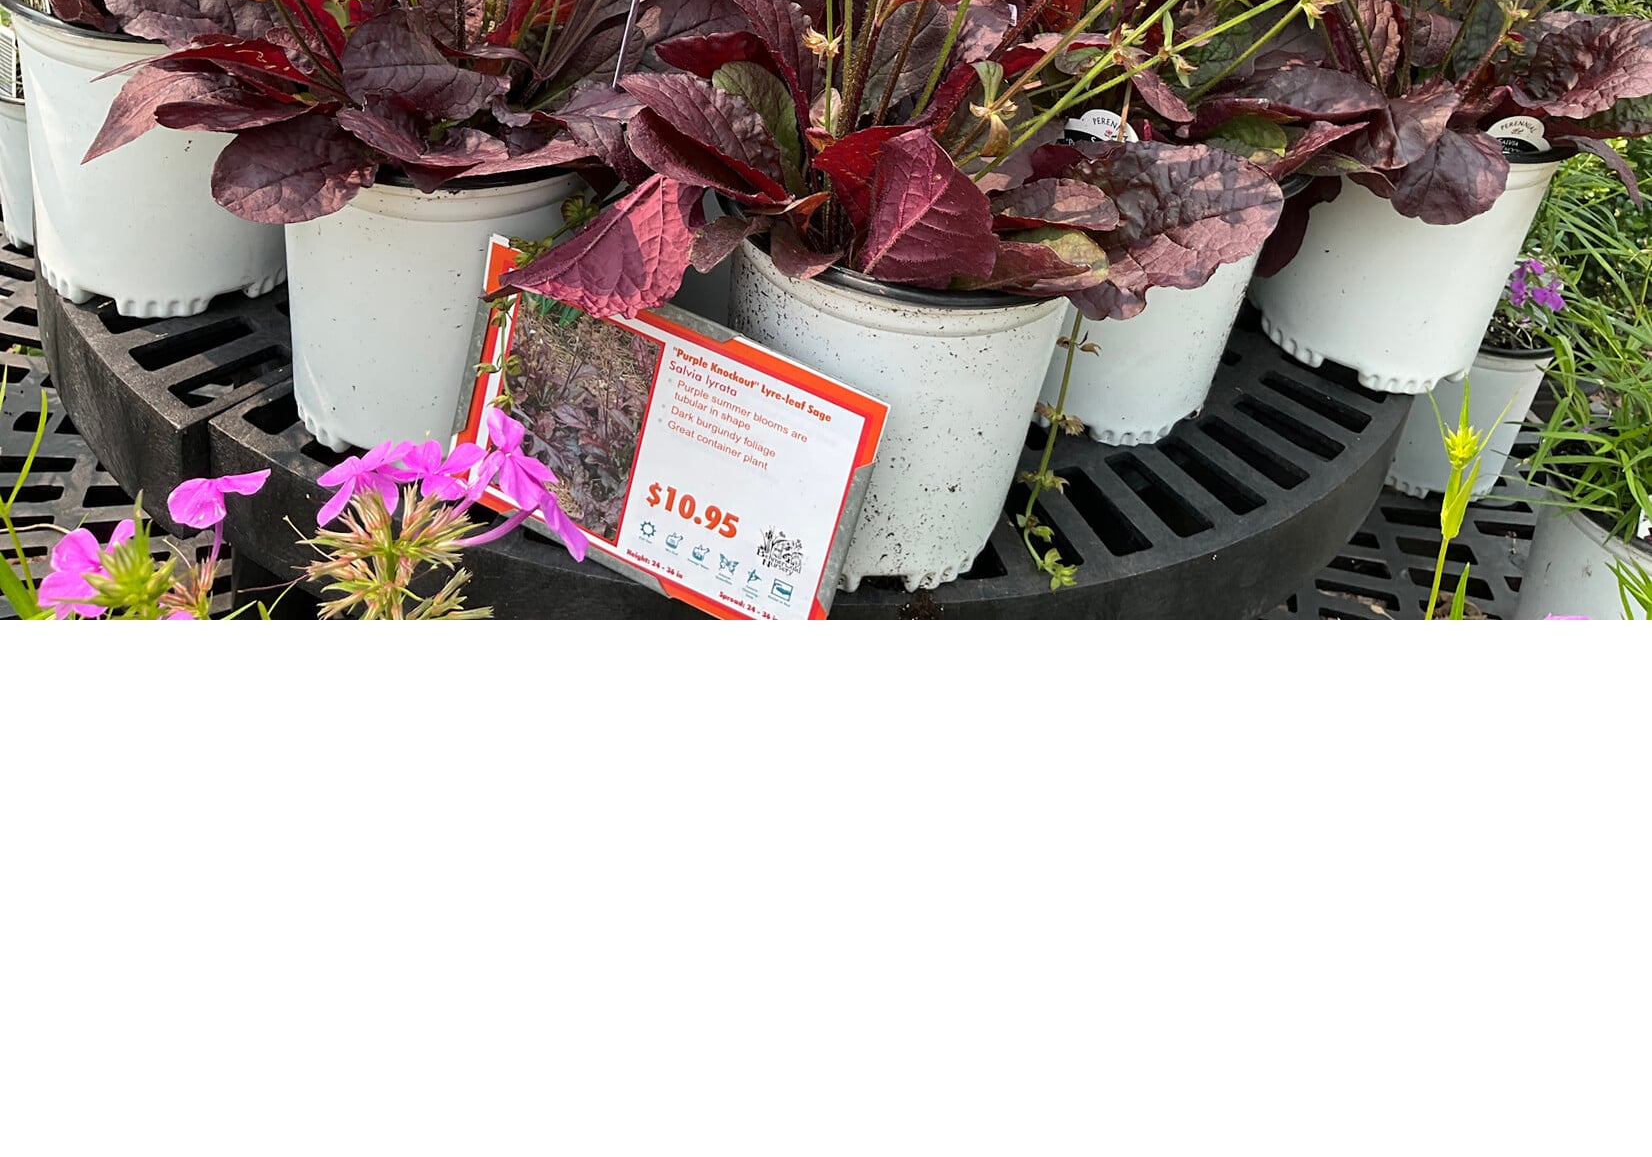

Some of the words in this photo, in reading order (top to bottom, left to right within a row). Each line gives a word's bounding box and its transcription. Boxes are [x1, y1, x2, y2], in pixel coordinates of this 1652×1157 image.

[669, 360, 702, 382] Salvia
[705, 374, 737, 397] lyrata
[672, 346, 708, 369] "Purple
[710, 362, 760, 389] Knockout"
[761, 384, 806, 411] Lyre-leaf
[807, 404, 832, 422] Sage
[671, 405, 694, 423] Dark
[696, 415, 742, 444] burgundy
[743, 436, 776, 458] foliage
[674, 391, 708, 411] tubular
[709, 406, 719, 417] in
[720, 411, 751, 431] shape
[677, 379, 709, 400] Purple
[711, 395, 751, 417] summer
[753, 412, 789, 435] blooms
[791, 430, 808, 443] are
[667, 420, 695, 439] Great
[696, 434, 742, 458] container
[743, 454, 768, 470] plant
[646, 481, 740, 539] $10.95
[626, 548, 651, 564] Height:
[651, 559, 661, 569] 24
[676, 572, 684, 580] in
[762, 558, 794, 576] Nursery
[719, 590, 746, 608] Spread:
[746, 603, 756, 614] 24
